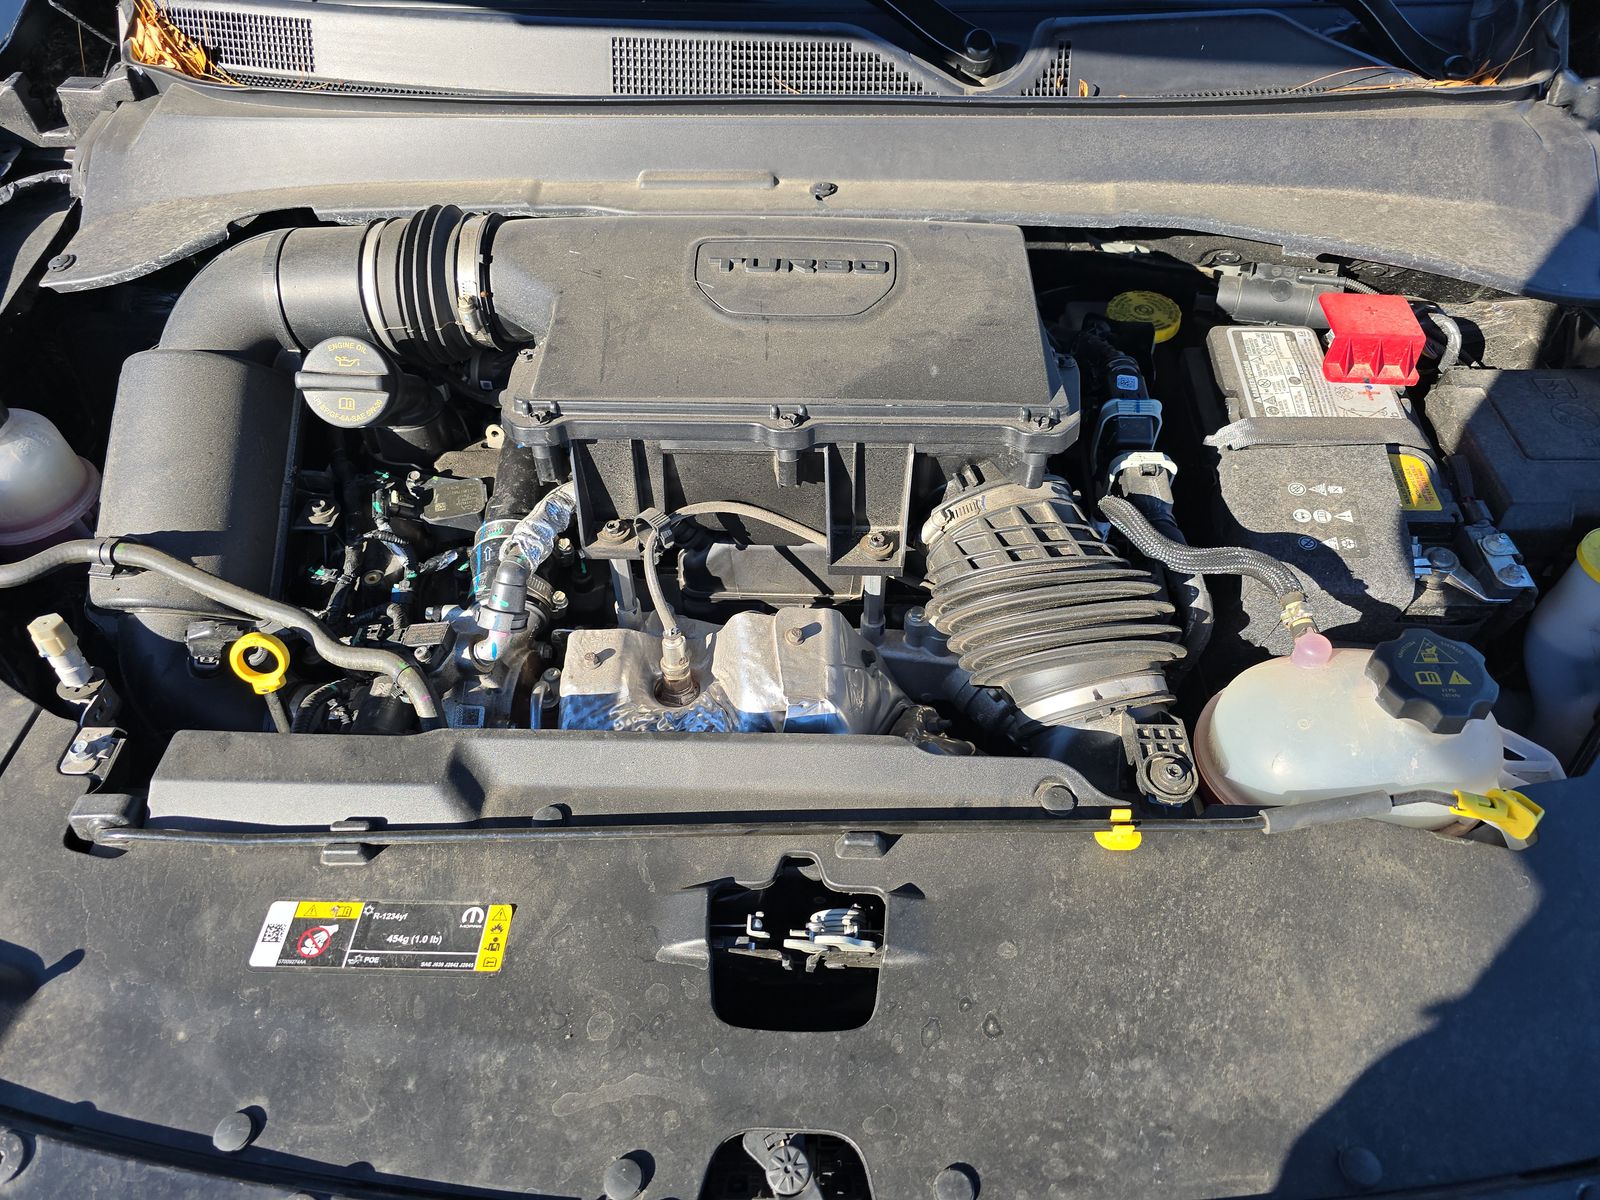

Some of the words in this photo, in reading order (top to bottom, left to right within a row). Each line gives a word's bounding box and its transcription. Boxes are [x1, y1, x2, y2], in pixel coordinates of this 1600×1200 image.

[708, 257, 889, 274] TURBO
[327, 342, 355, 352] ENGINE
[355, 344, 368, 354] OIL
[372, 912, 408, 922] R-1234yf
[386, 934, 410, 945] 454g
[411, 934, 429, 945] (1.0
[430, 934, 442, 946] lb)
[363, 956, 380, 964] POE
